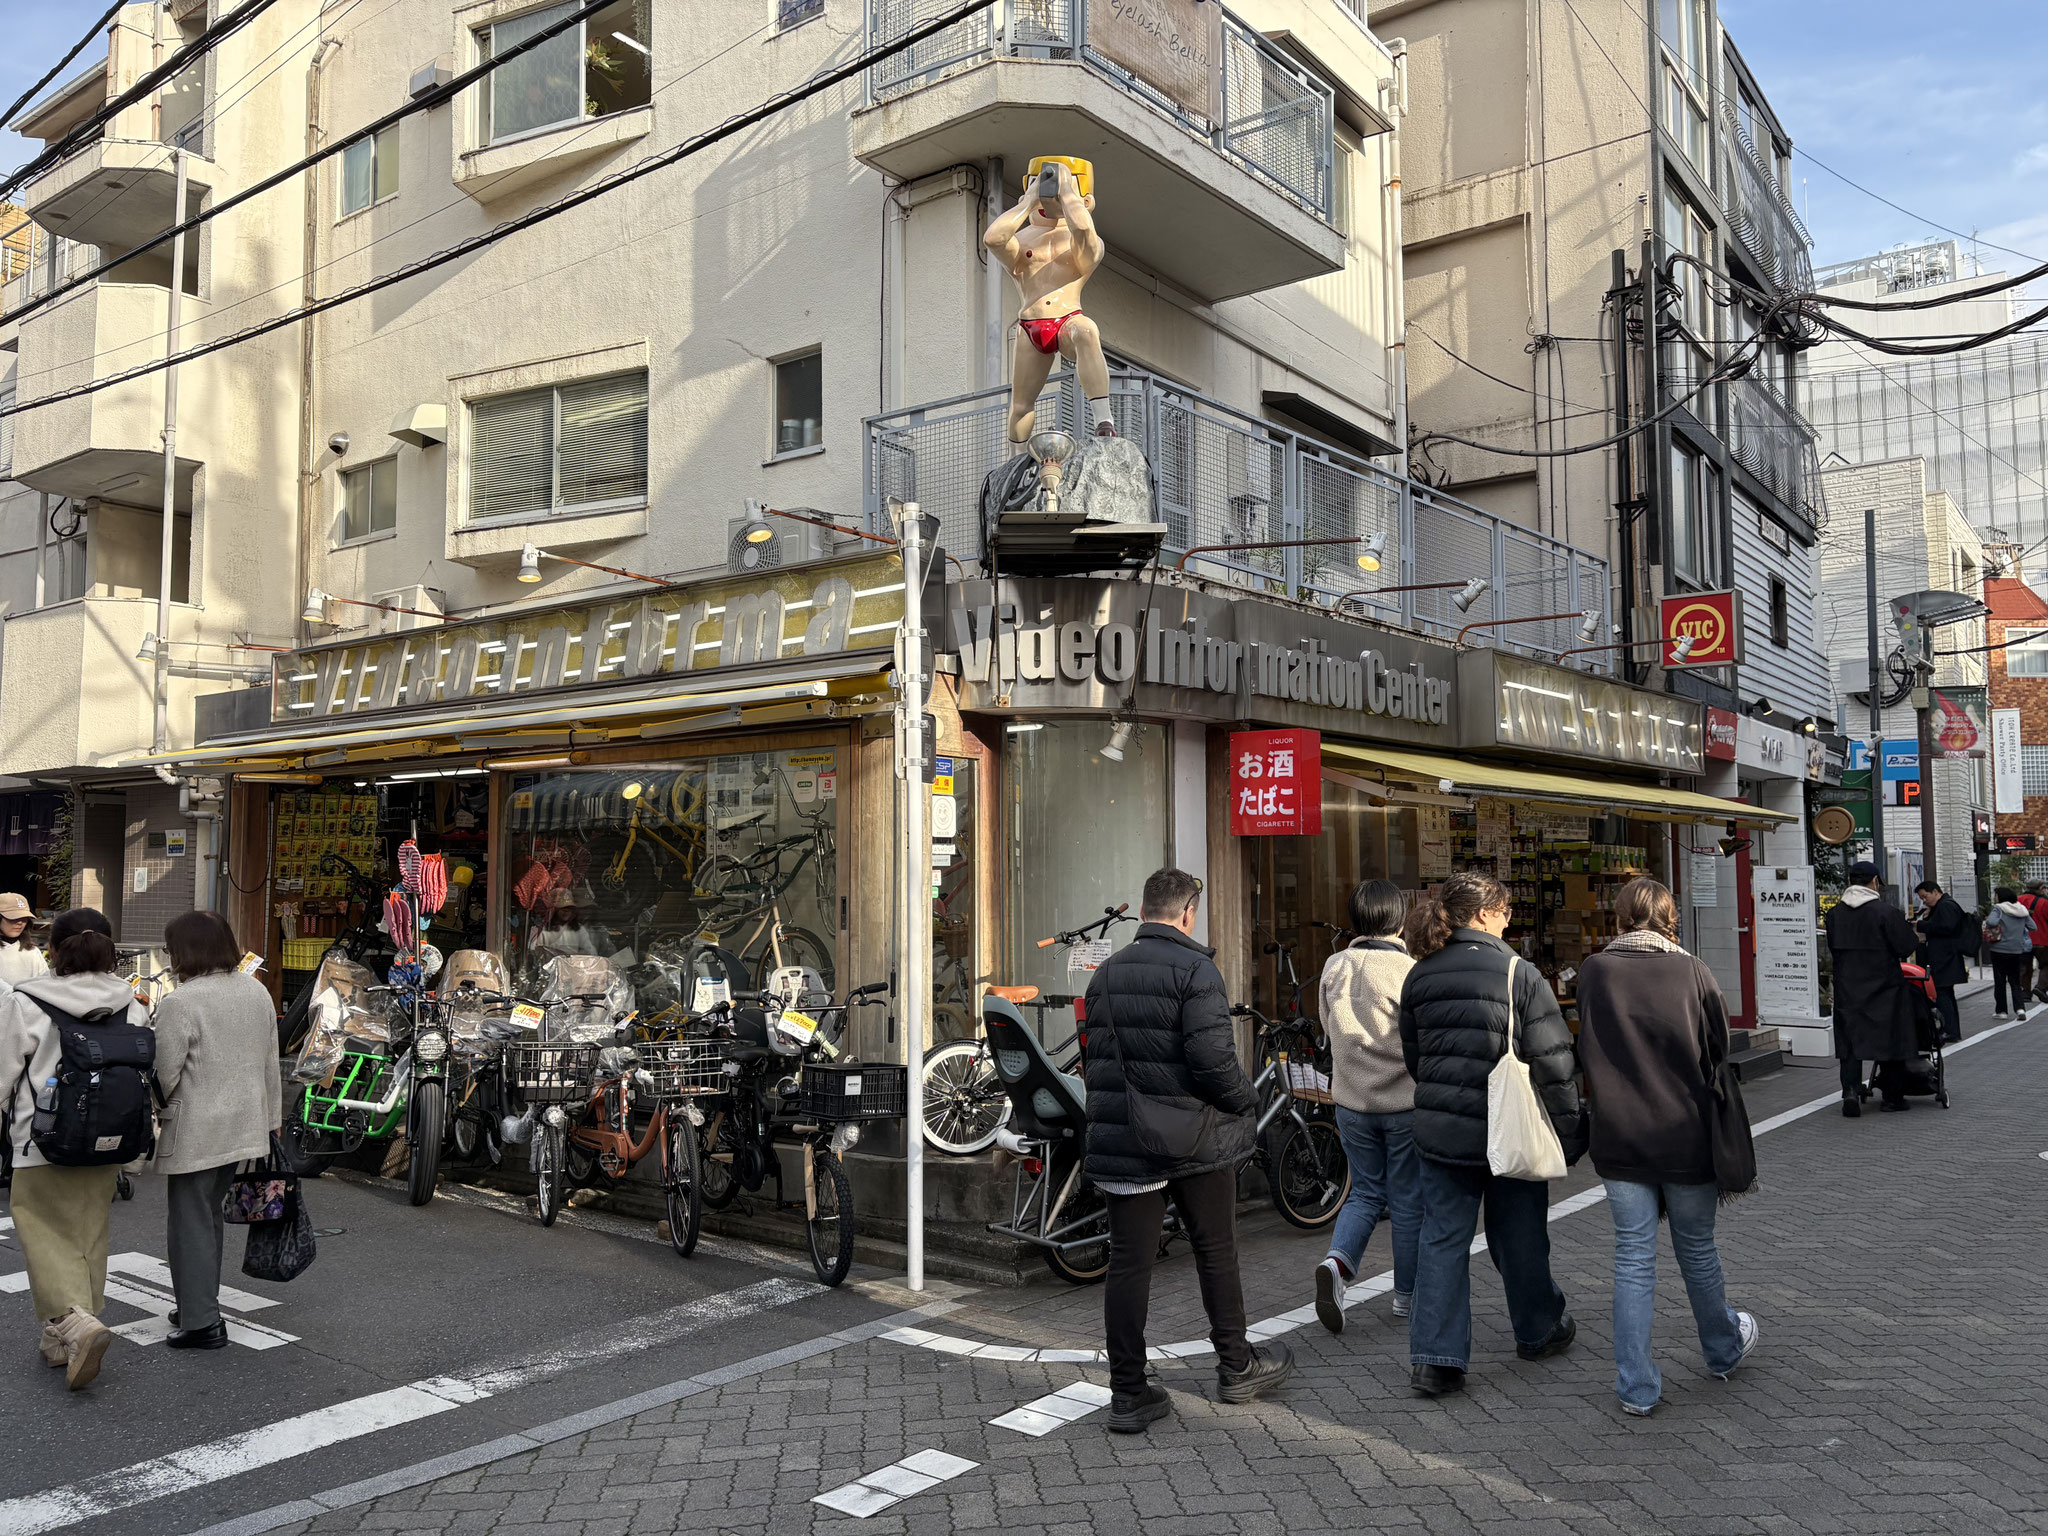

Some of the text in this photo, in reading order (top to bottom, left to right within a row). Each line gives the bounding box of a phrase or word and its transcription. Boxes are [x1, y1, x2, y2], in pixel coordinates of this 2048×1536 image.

[1168, 34, 1211, 67] Bella
[1681, 619, 1714, 640] VIC
[952, 604, 1136, 683] Video
[1140, 608, 1364, 708] Information
[1360, 649, 1451, 726] Center
[1238, 749, 1294, 779] お酒
[1238, 784, 1295, 816] たばこ
[1256, 820, 1295, 828] CIGARETTE
[1760, 891, 1805, 903] SAFARI
